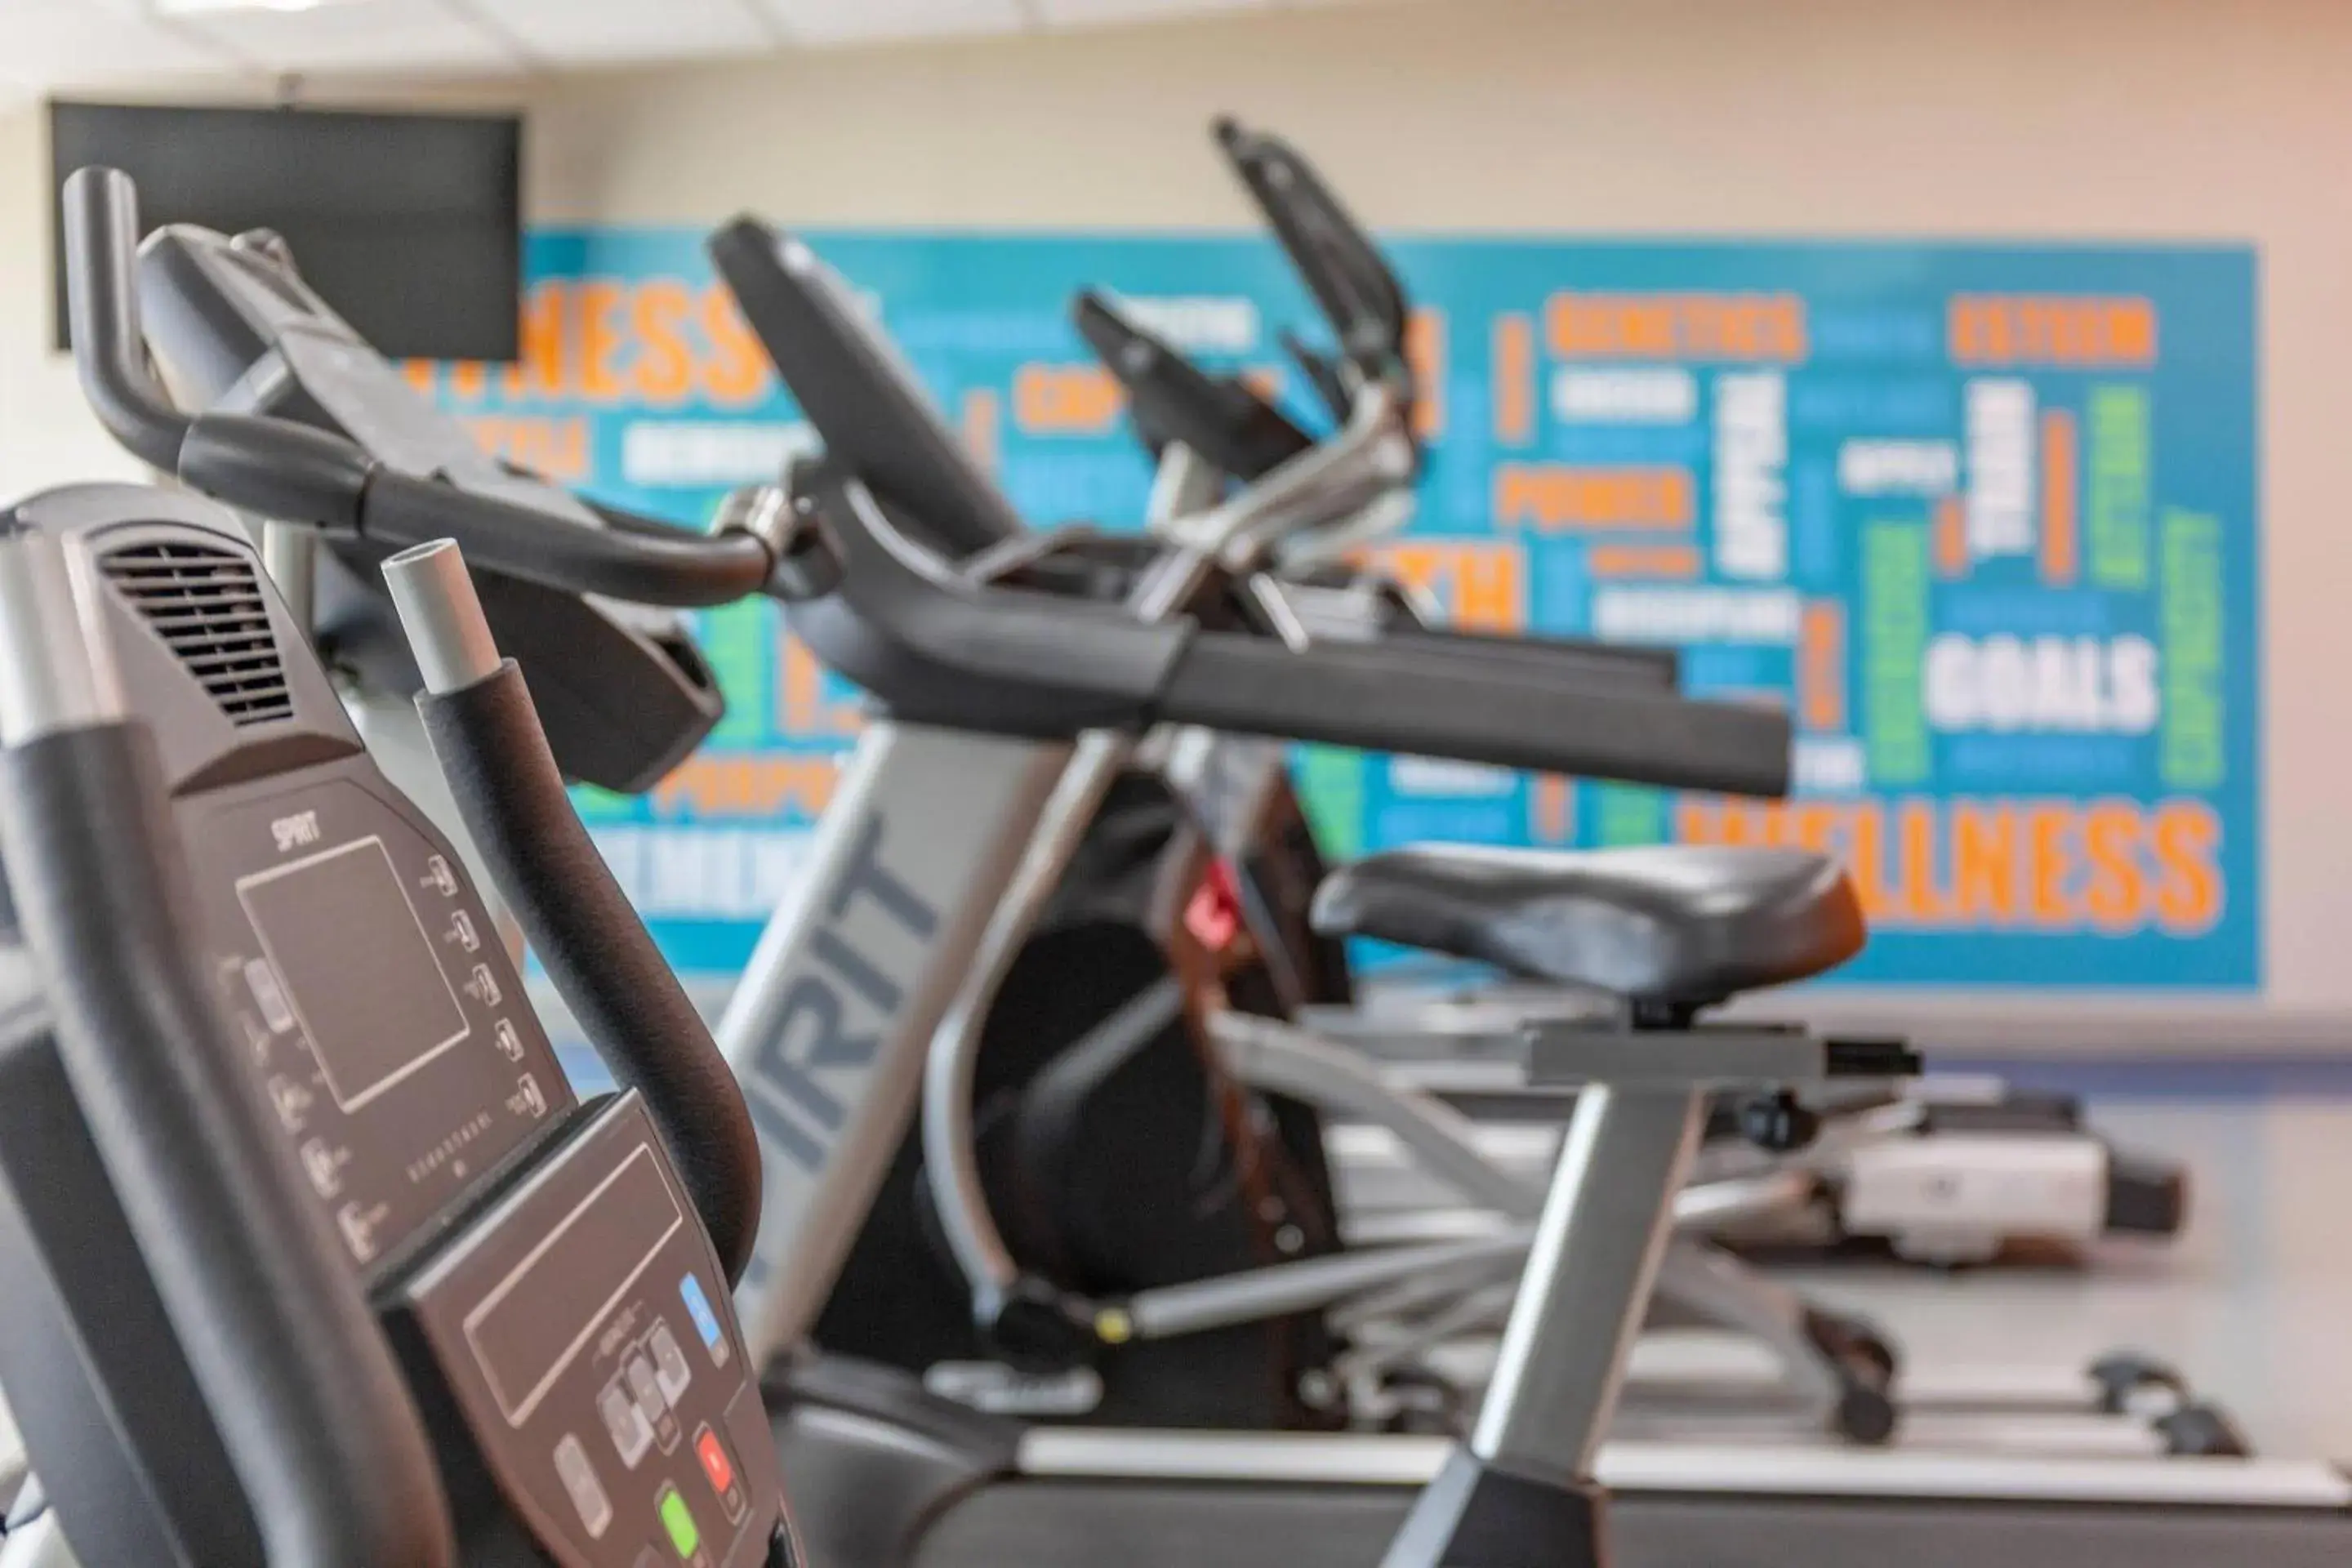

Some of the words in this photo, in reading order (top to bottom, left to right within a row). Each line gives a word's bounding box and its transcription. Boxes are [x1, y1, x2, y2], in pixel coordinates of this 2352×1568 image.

[400, 274, 776, 402] NESS
[1925, 634, 2159, 732] GOALS
[742, 810, 939, 1180] IRIT
